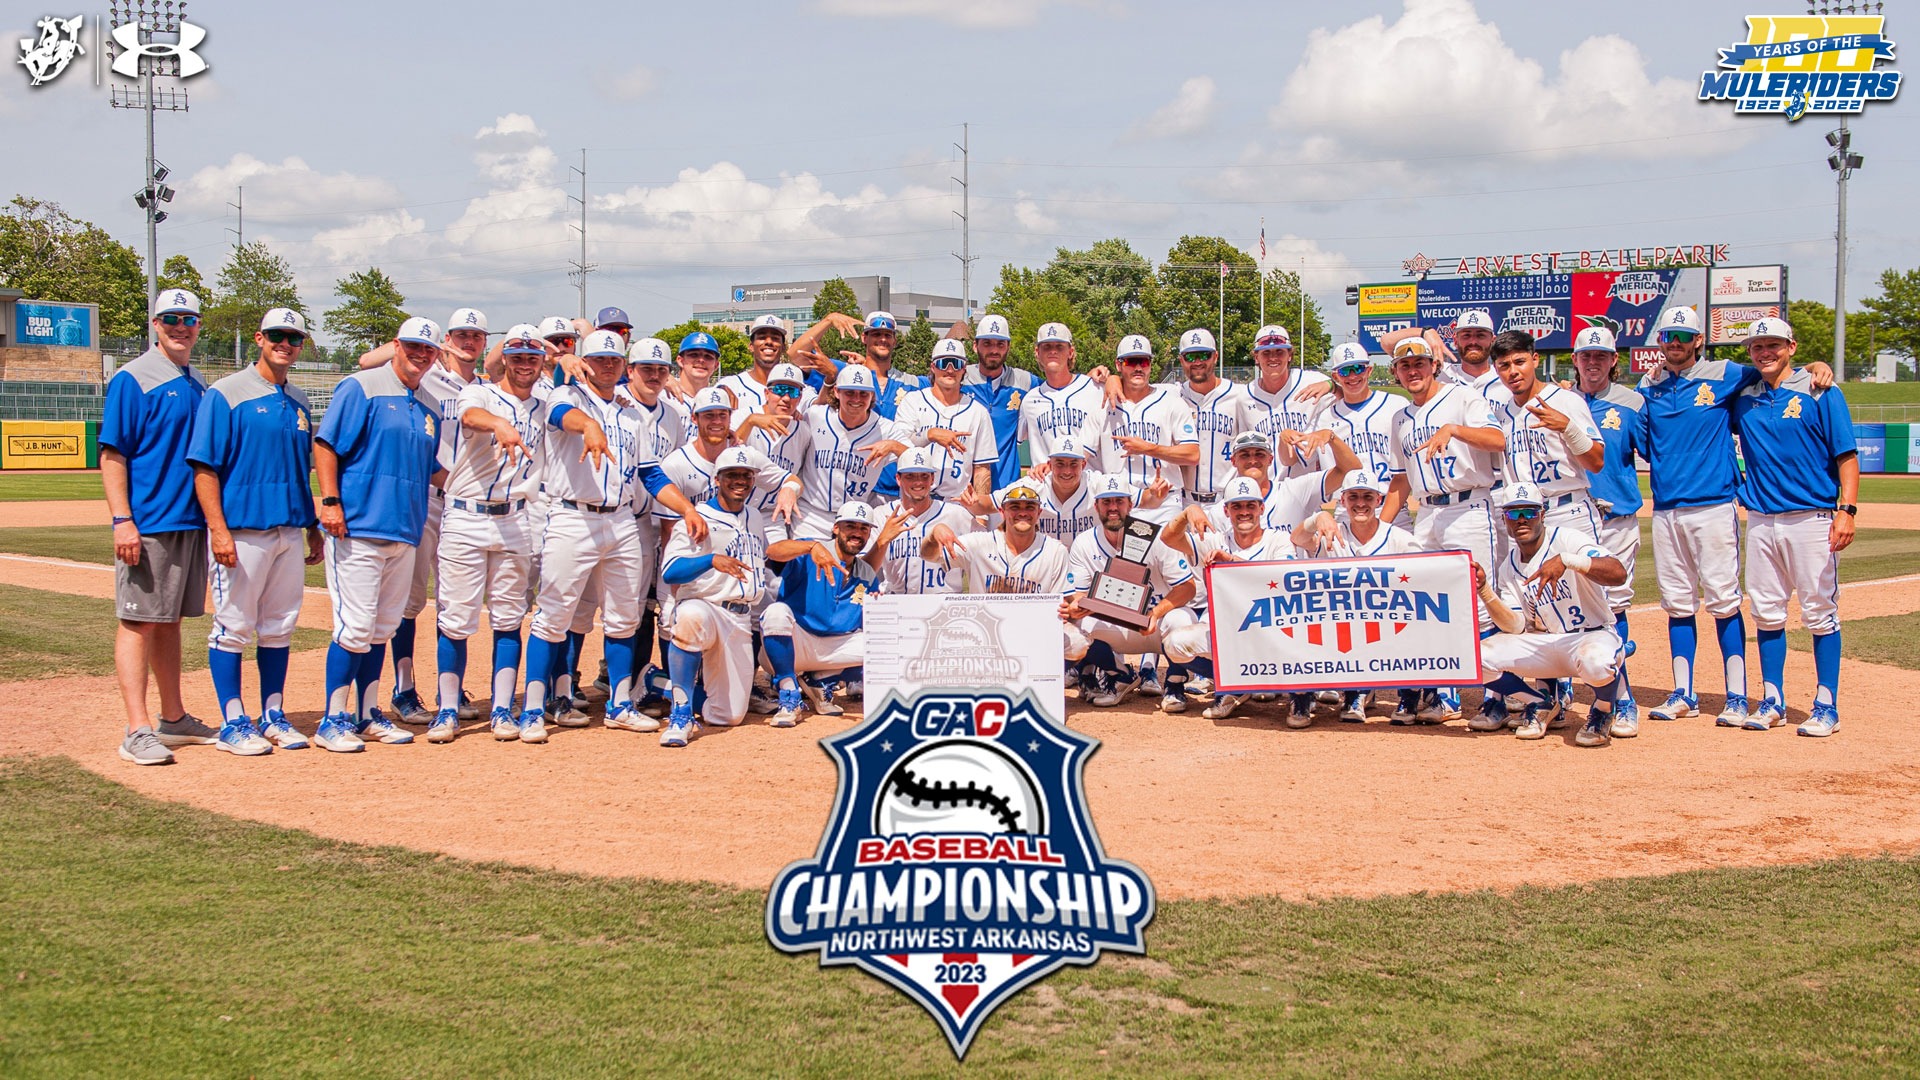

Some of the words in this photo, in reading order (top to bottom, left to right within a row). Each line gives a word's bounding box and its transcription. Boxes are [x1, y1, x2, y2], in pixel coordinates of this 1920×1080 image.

[1456, 252, 1561, 275] ARVEST
[1580, 244, 1728, 269] BALLPARK
[1622, 274, 1653, 282] GREAT
[1364, 288, 1379, 297] PLAZA
[1392, 287, 1412, 295] SERVICE
[1546, 285, 1551, 293] 0
[1562, 285, 1568, 293] 0
[1606, 282, 1668, 297] AMERICAN
[1514, 308, 1548, 316] GREAT
[28, 317, 50, 327] BUD
[1498, 316, 1565, 332] AMERICAN
[1625, 318, 1646, 336] VS
[26, 326, 54, 336] LIGHT
[1727, 328, 1748, 338] PUN
[1634, 351, 1666, 360] UAMS
[1639, 361, 1661, 370] Hea
[1198, 411, 1234, 436] ERIDERS
[950, 459, 964, 479] 5
[1436, 456, 1457, 479] 17
[1534, 460, 1562, 483] 27
[847, 480, 868, 497] 48
[1039, 516, 1094, 534] MULERIDERS
[926, 567, 946, 588] 10
[1284, 566, 1396, 592] GREAT
[948, 606, 978, 618] GAC
[1238, 590, 1450, 632] AMERICAN
[1276, 612, 1412, 626] CONFERENCE
[1568, 606, 1586, 626] 3
[931, 648, 996, 658] BASEBALL
[906, 658, 1022, 681] CHAMPIONSHIP
[1240, 662, 1278, 676] 2023
[1282, 660, 1364, 675] BASEBALL
[1369, 657, 1460, 672] CHAMPION
[923, 678, 966, 686] NORTHWEST
[968, 678, 1006, 686] ARKANSAS
